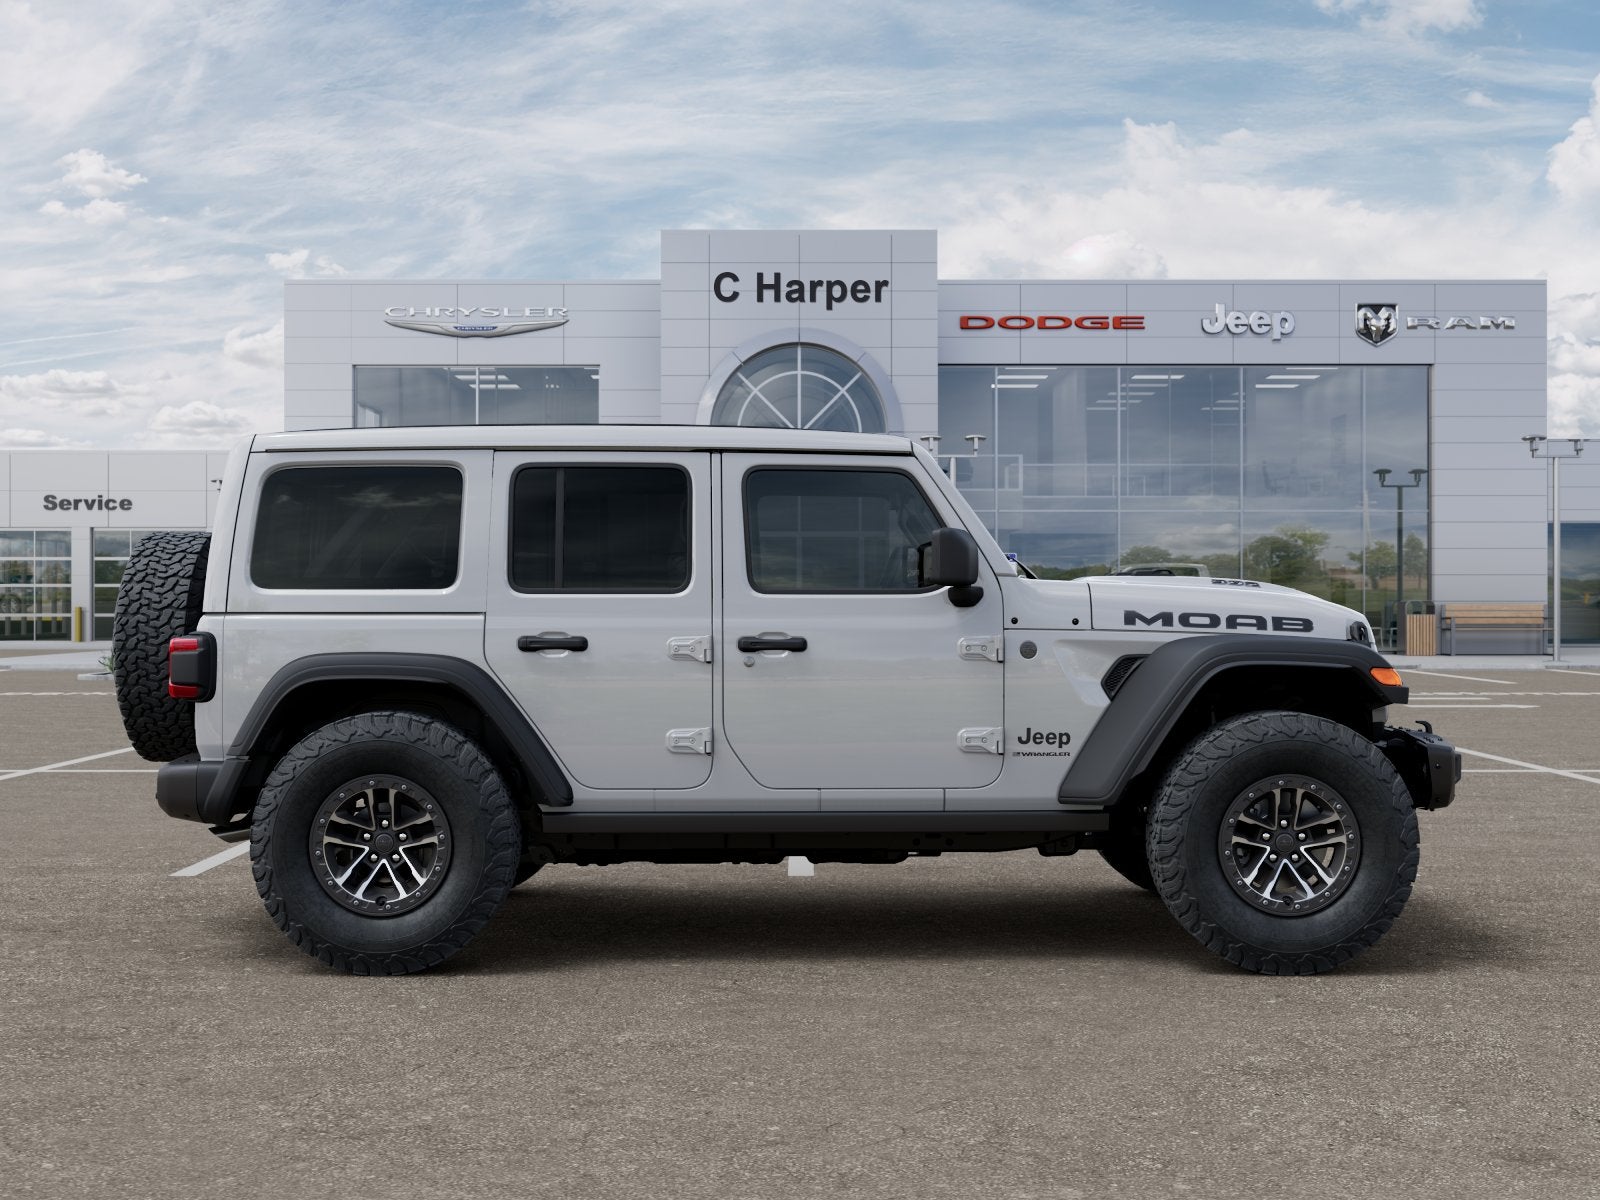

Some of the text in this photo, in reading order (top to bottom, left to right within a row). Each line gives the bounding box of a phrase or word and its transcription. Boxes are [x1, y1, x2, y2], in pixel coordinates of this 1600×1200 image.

[713, 271, 889, 311] C Harper
[384, 306, 569, 318] CHRYSLER
[959, 315, 1145, 330] DODGE
[1201, 302, 1295, 342] Jeep
[1406, 316, 1516, 330] RAM
[43, 494, 133, 511] Service
[1123, 609, 1314, 633] MOAB
[1017, 727, 1071, 749] Jeep
